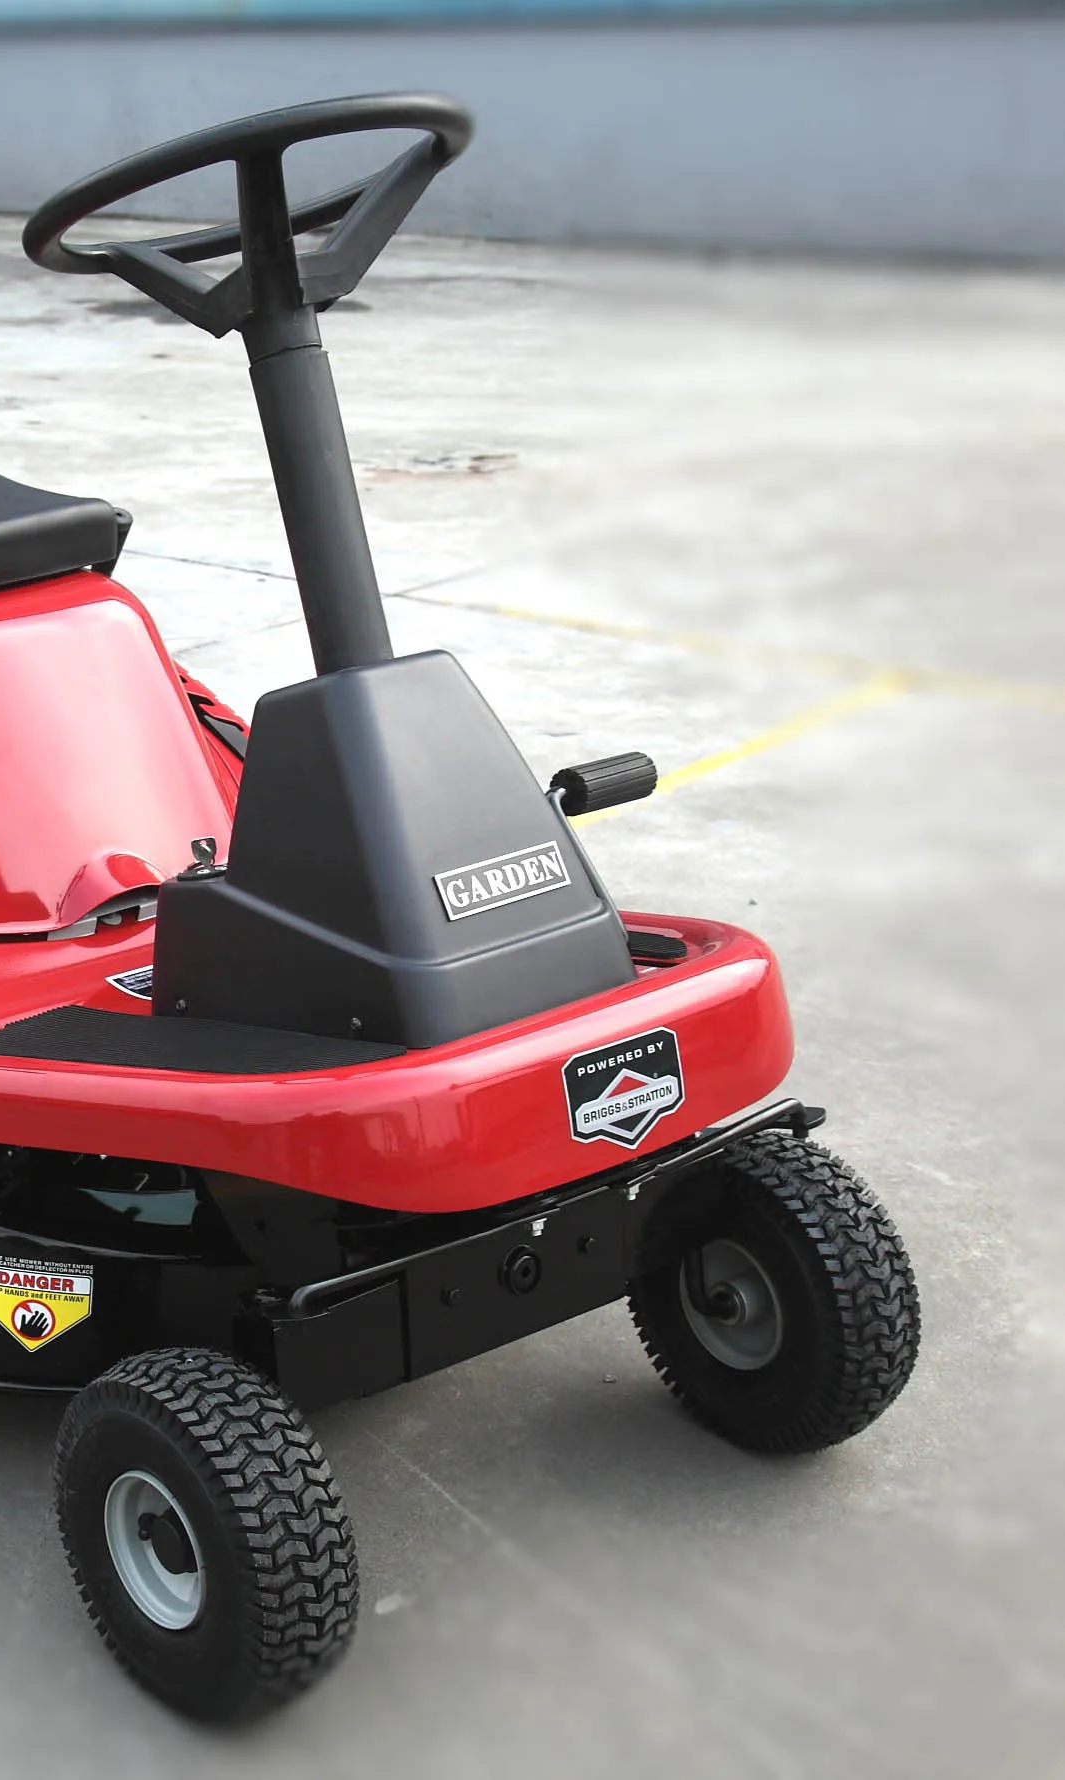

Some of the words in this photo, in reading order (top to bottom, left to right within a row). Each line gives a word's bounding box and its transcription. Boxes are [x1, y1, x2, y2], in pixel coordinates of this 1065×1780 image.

[446, 851, 563, 908] GARDEN
[577, 1048, 643, 1077] POWERED
[647, 1041, 664, 1054] BY
[35, 1265, 68, 1273] DEFLECTOR
[4, 1288, 29, 1298] HANDS
[31, 1292, 44, 1300] and
[45, 1293, 62, 1301] FEET
[63, 1295, 85, 1303] AWAY
